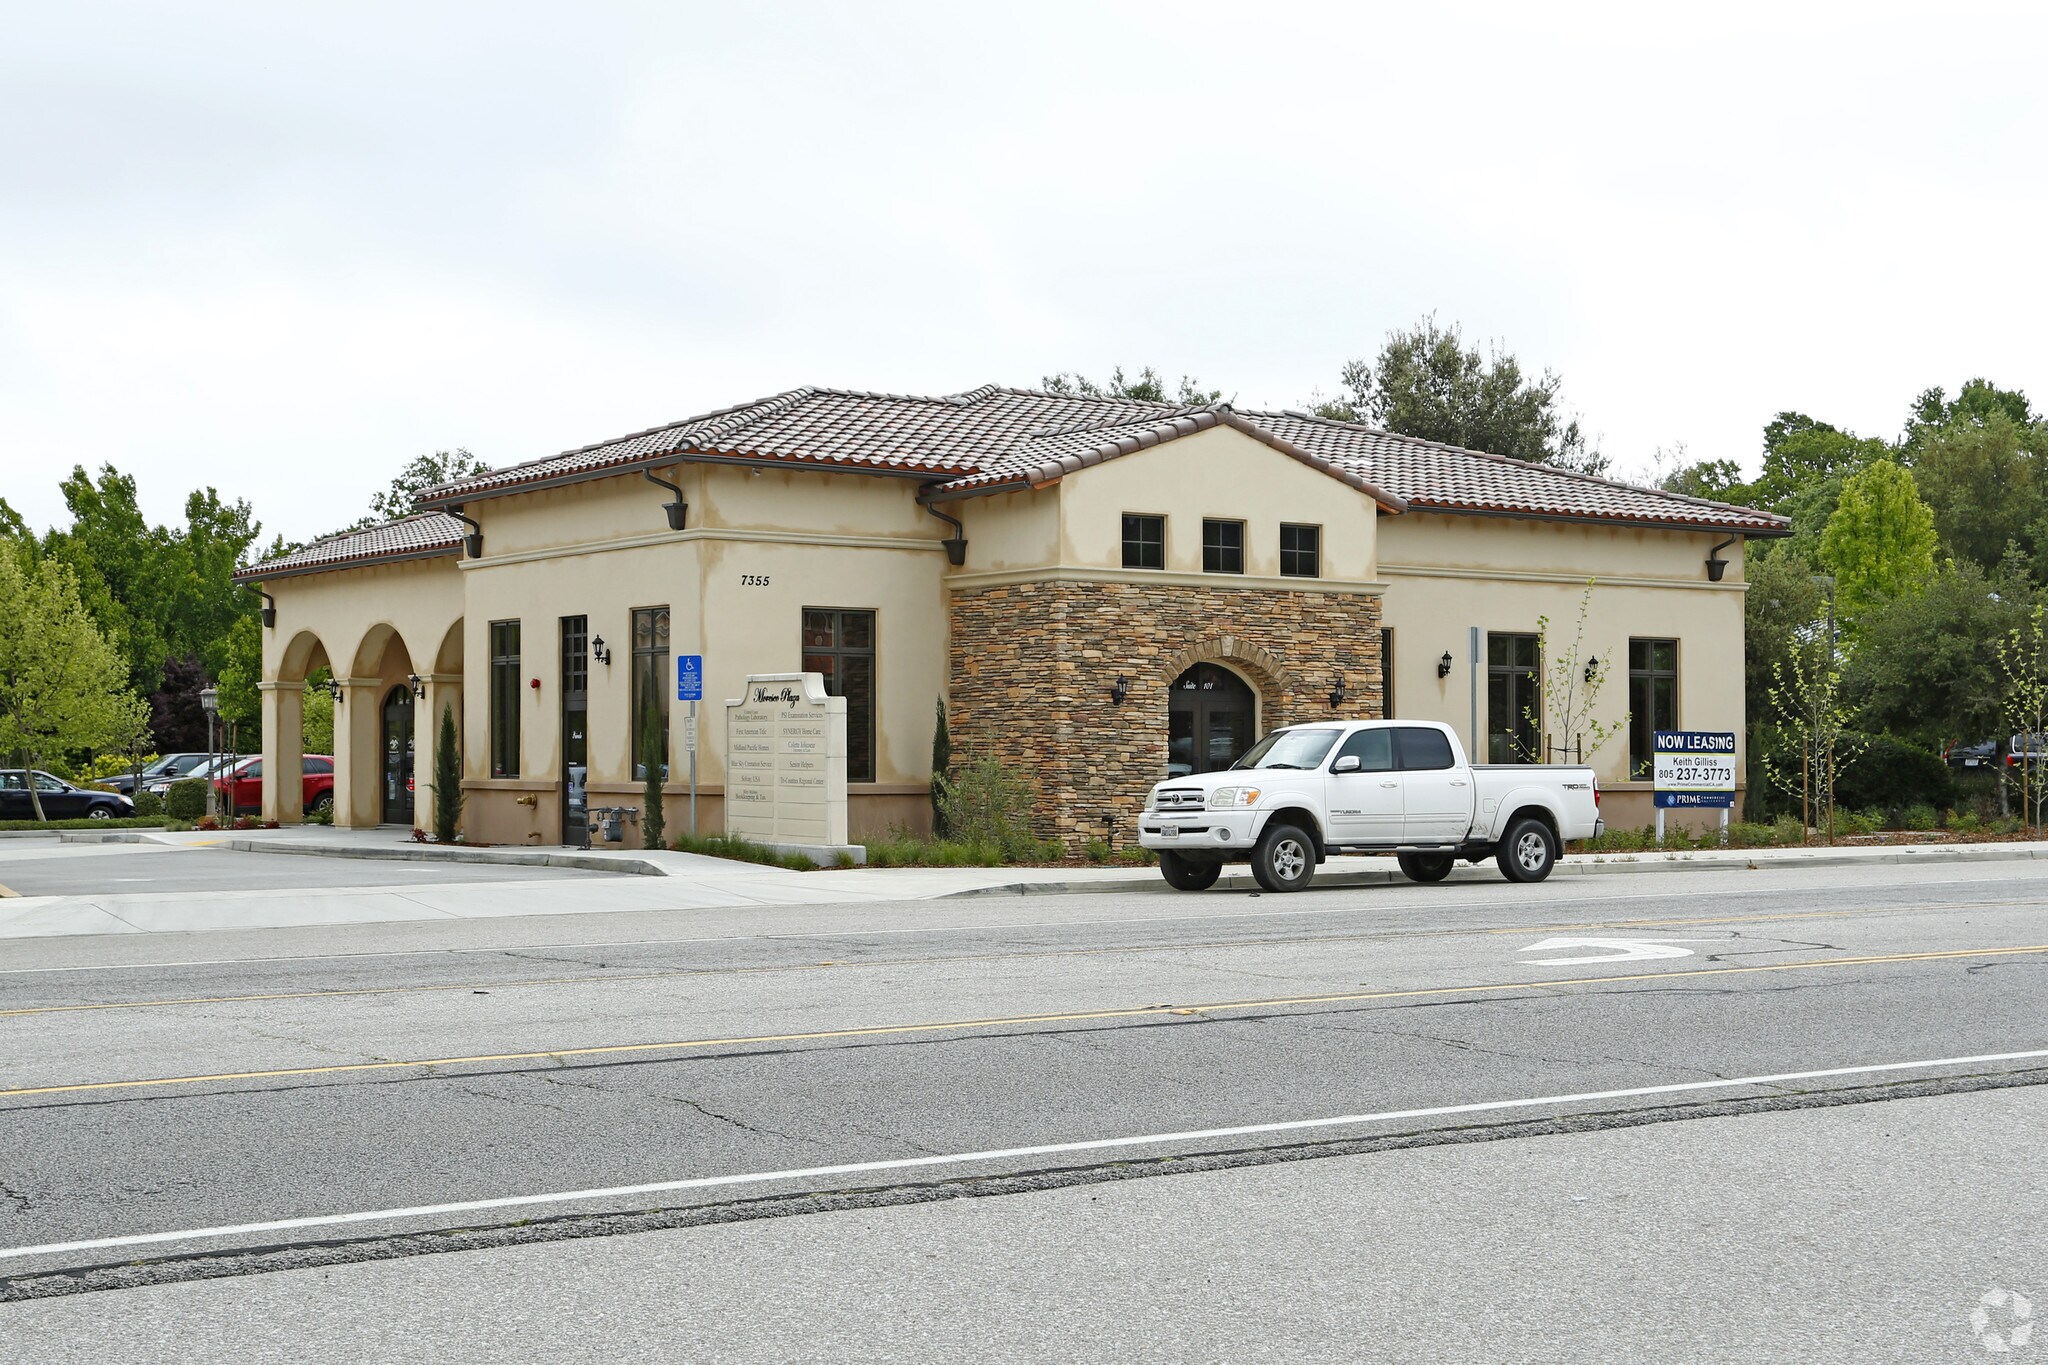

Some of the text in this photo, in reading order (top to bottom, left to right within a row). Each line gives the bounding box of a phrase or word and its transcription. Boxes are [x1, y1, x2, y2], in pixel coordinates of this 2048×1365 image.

[741, 575, 770, 586] 7355
[780, 687, 800, 709] Plaza
[1658, 735, 1733, 750] NOW LEASING
[801, 761, 814, 769] Helpers
[1673, 757, 1718, 766] Keith Gilliss
[1658, 768, 1731, 781] 805 237-3773
[812, 777, 824, 785] Center
[1676, 795, 1701, 804] PRIME
